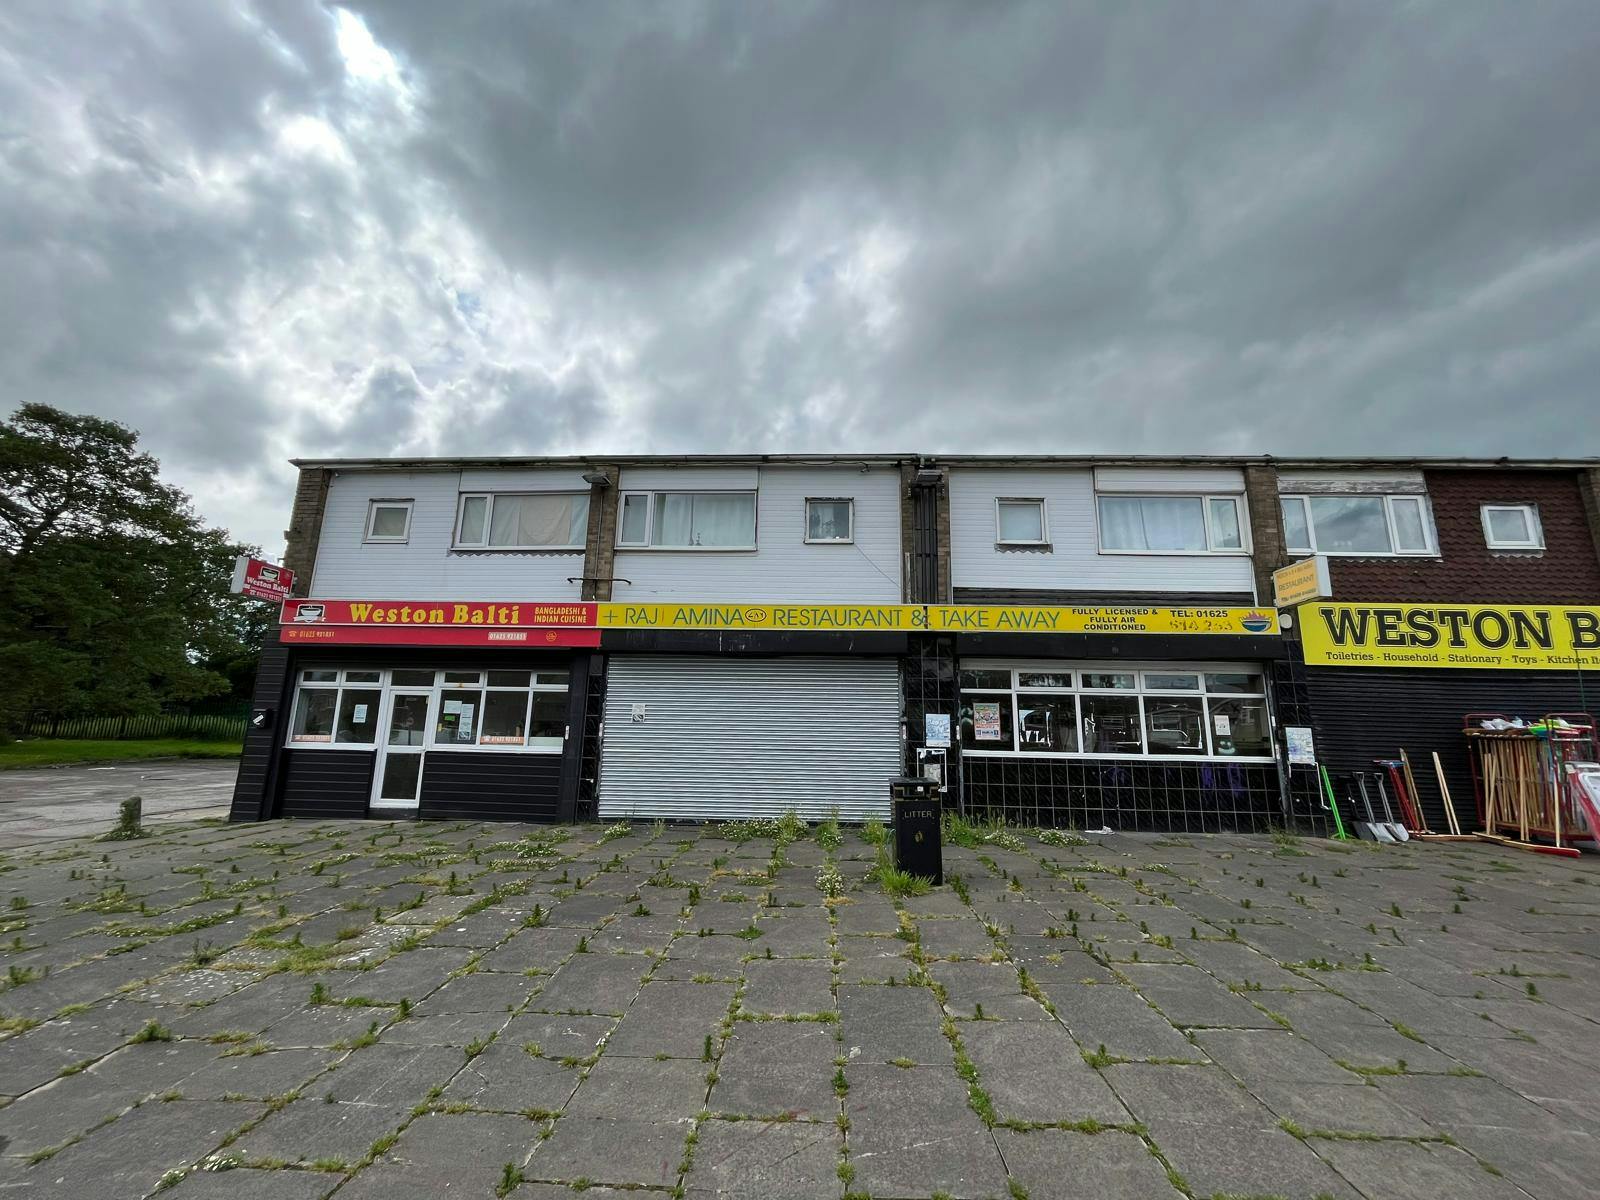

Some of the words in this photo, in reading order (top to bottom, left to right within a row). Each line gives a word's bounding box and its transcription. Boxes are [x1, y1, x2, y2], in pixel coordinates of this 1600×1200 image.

[247, 577, 272, 589] Weston
[273, 583, 289, 593] Balti
[349, 603, 444, 623] Weston
[452, 604, 520, 624] Balti
[534, 615, 558, 623] INDIAN
[535, 607, 580, 615] BANGLADESHI
[625, 608, 658, 625] RAJ
[672, 608, 745, 625] AMINA
[772, 608, 902, 626] RESTAURANT
[939, 610, 989, 627] TAKE
[996, 610, 1060, 628] AWAY
[1320, 607, 1554, 650] WESTON
[1326, 652, 1373, 660] Toiletries
[1383, 653, 1439, 662] Household
[1448, 654, 1502, 664] Stationary
[1512, 655, 1538, 664] Toys
[1547, 655, 1589, 664] Kitchen
[904, 810, 932, 818] LITTER
